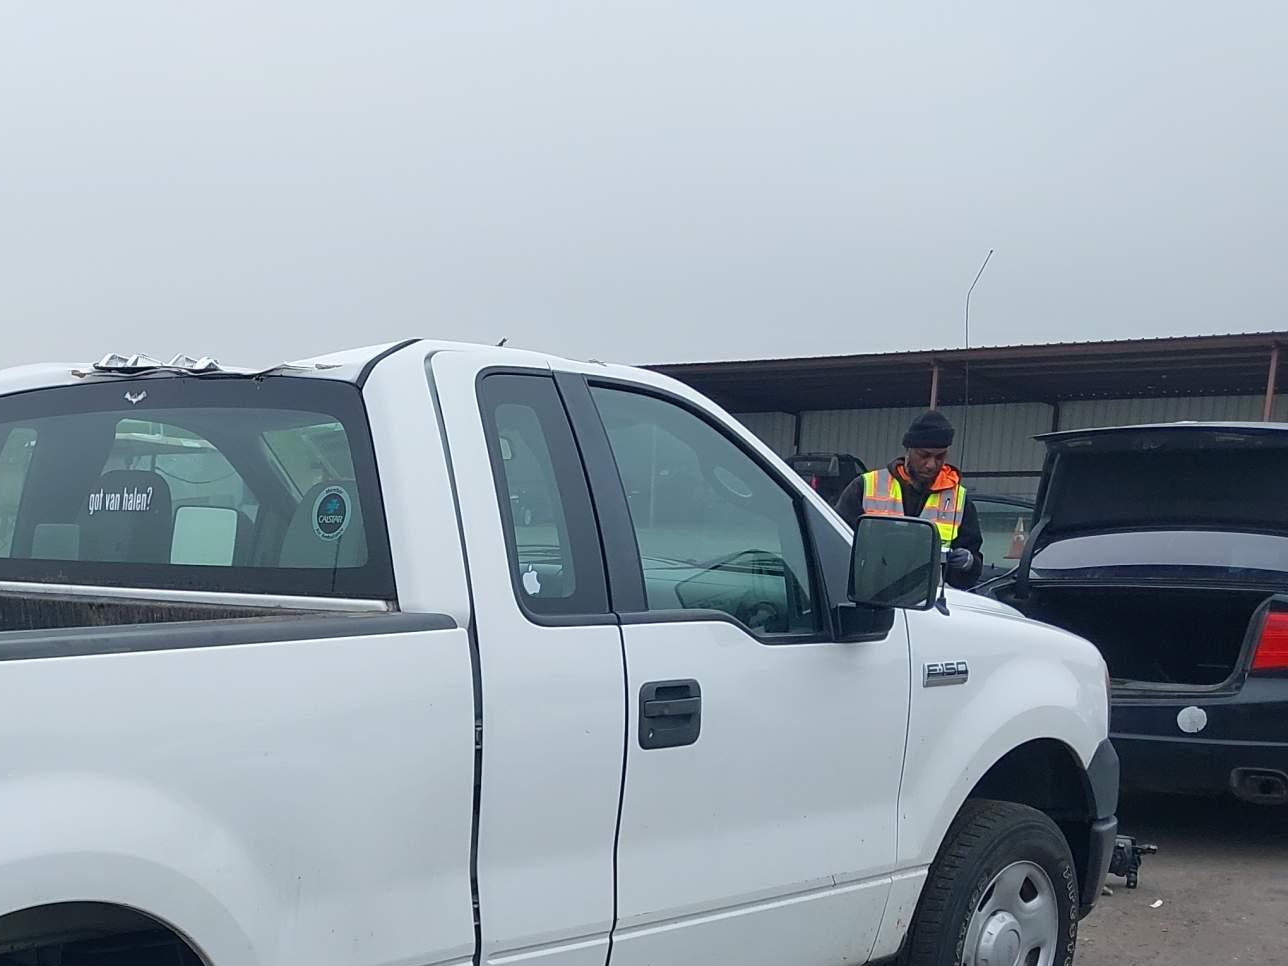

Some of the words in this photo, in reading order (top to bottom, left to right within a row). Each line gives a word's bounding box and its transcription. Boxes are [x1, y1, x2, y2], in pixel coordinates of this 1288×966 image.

[89, 488, 104, 515] got
[105, 493, 121, 511] van
[122, 486, 153, 511] halen?
[318, 514, 343, 524] CALSTAR
